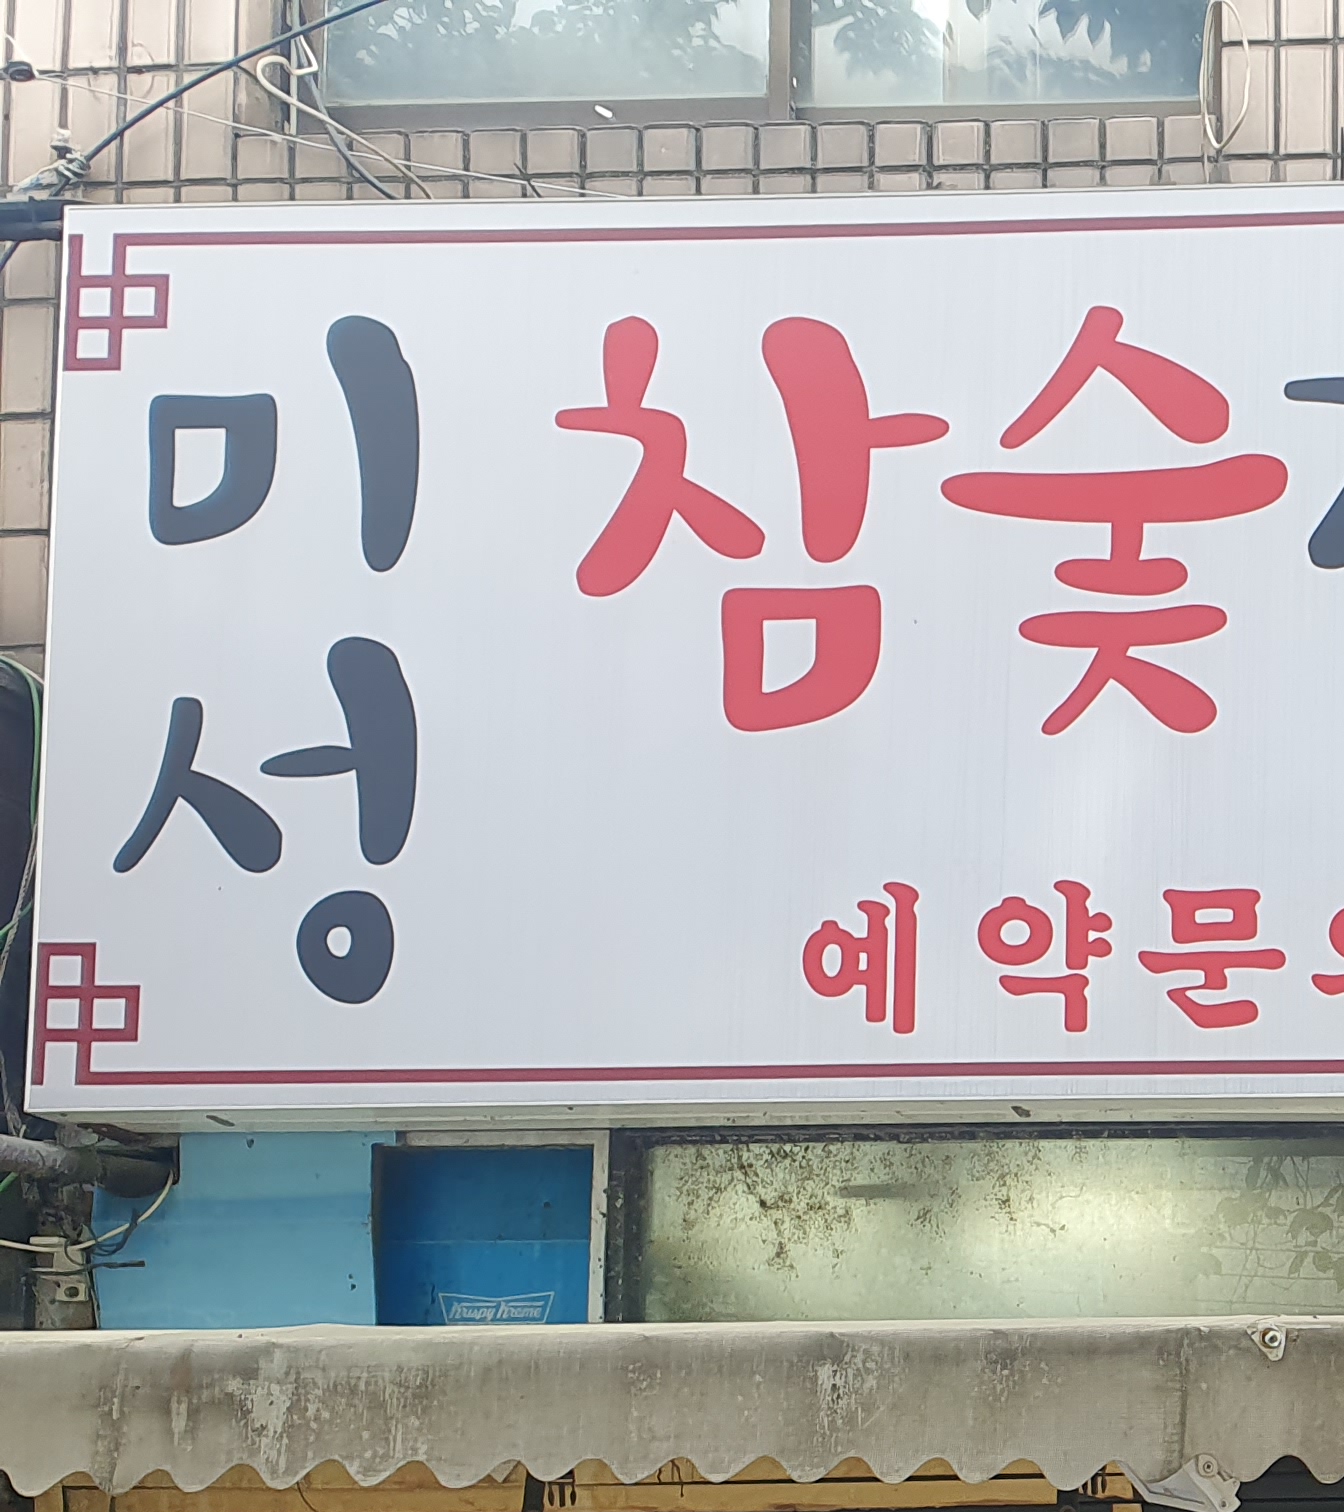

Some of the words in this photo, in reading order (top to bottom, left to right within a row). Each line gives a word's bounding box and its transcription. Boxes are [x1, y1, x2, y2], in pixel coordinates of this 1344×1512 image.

[114, 315, 419, 1003] 미성
[449, 1301, 497, 1321] Krispy
[496, 1301, 545, 1319] Kreme
